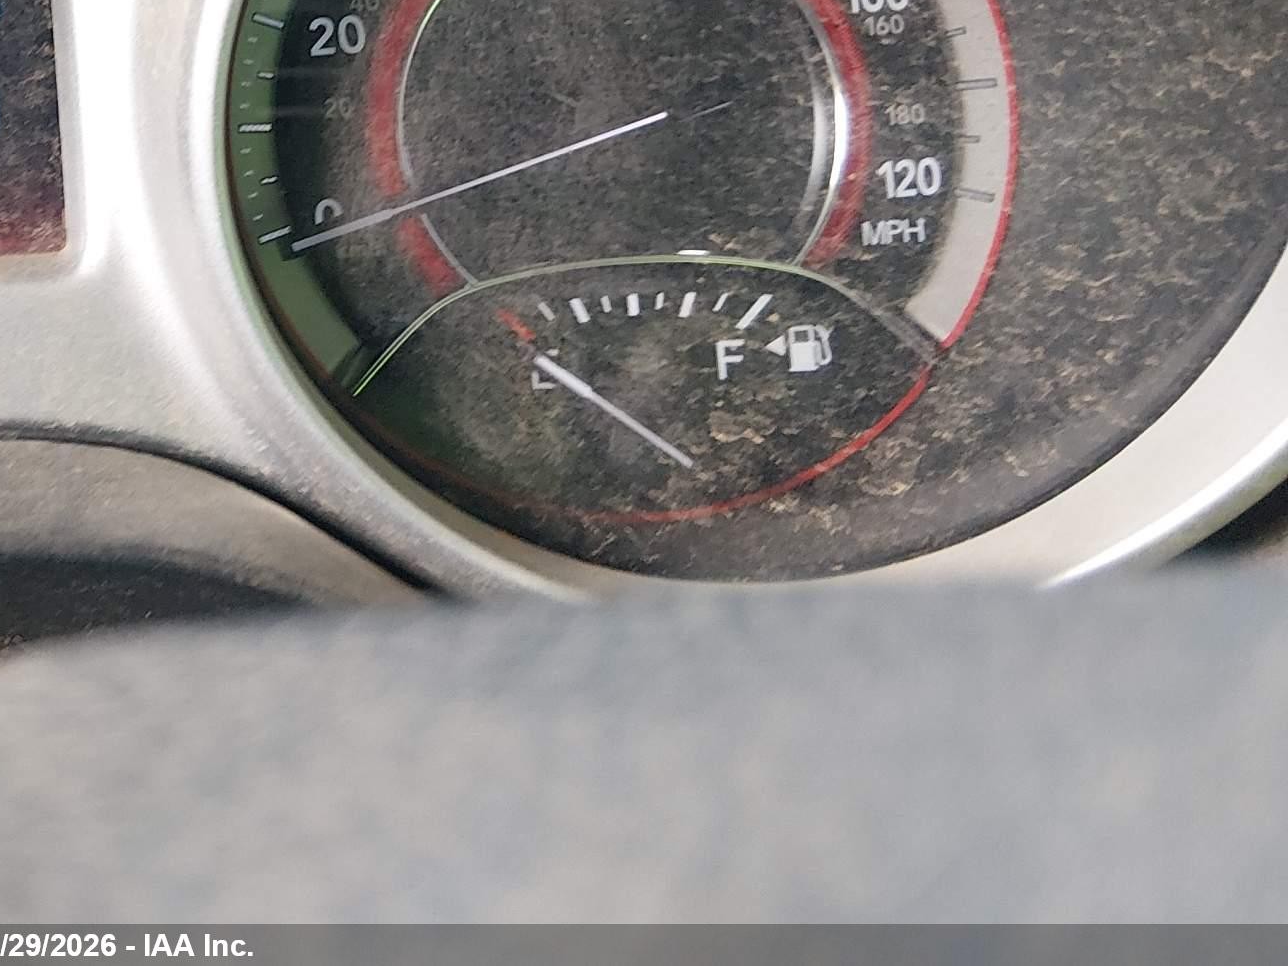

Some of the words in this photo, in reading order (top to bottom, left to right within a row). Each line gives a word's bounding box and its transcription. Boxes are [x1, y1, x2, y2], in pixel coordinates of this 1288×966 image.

[309, 14, 365, 57] 20
[864, 14, 905, 35] 160
[885, 103, 925, 125] 180
[876, 157, 942, 199] 120
[861, 218, 926, 246] MPH
[716, 339, 746, 380] F
